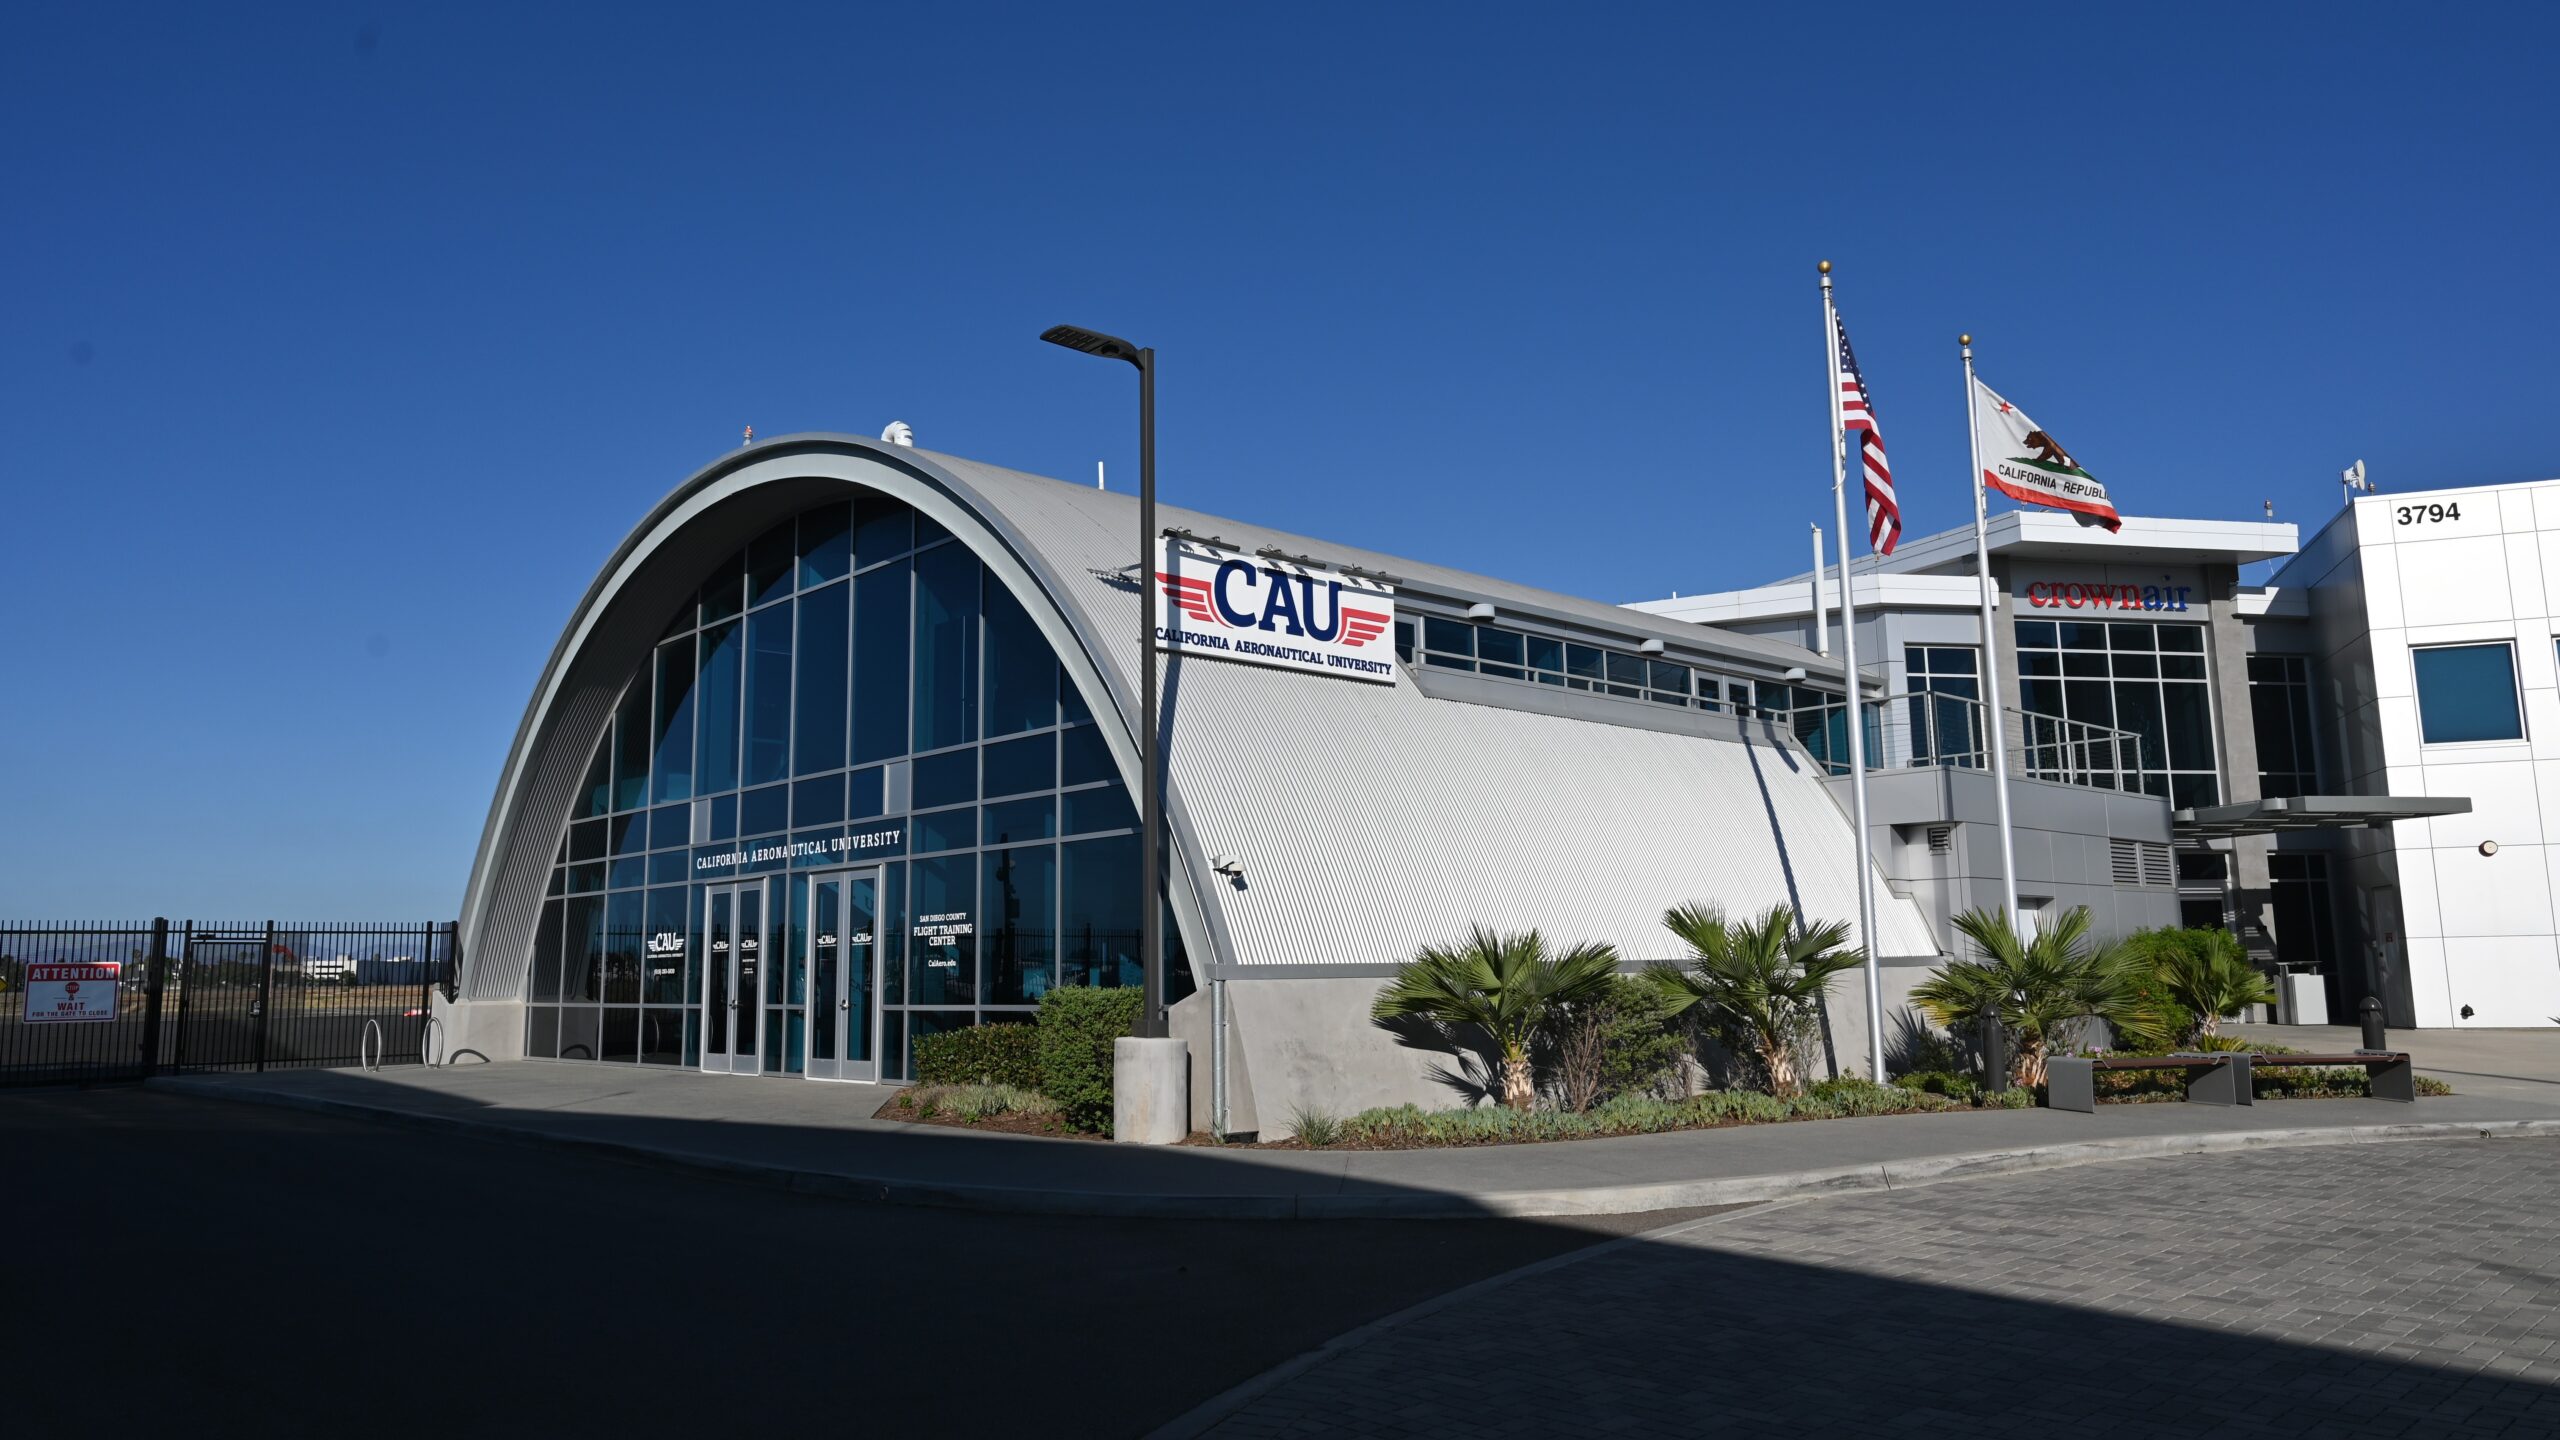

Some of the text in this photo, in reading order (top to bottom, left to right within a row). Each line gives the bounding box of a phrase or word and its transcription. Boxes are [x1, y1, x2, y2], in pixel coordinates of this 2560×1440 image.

[1998, 464, 2057, 490] CALIFORNIA
[2397, 502, 2461, 526] 3794
[1214, 559, 1343, 642] CAU
[2027, 574, 2192, 612] crownair
[1155, 627, 1392, 675] CALIFORNIA AERONAUTICAL UNIVERSITY
[697, 830, 900, 870] CALIFORNIA AERONAUTICAL UNIVERSITY
[919, 912, 967, 923] SAN DIEGO COUNTY
[913, 923, 973, 937] FLIGHT TRAINING
[928, 935, 956, 946] CENTER
[655, 932, 677, 951] CAU
[32, 967, 115, 979] ATTENTION
[57, 1002, 85, 1010] WAIT
